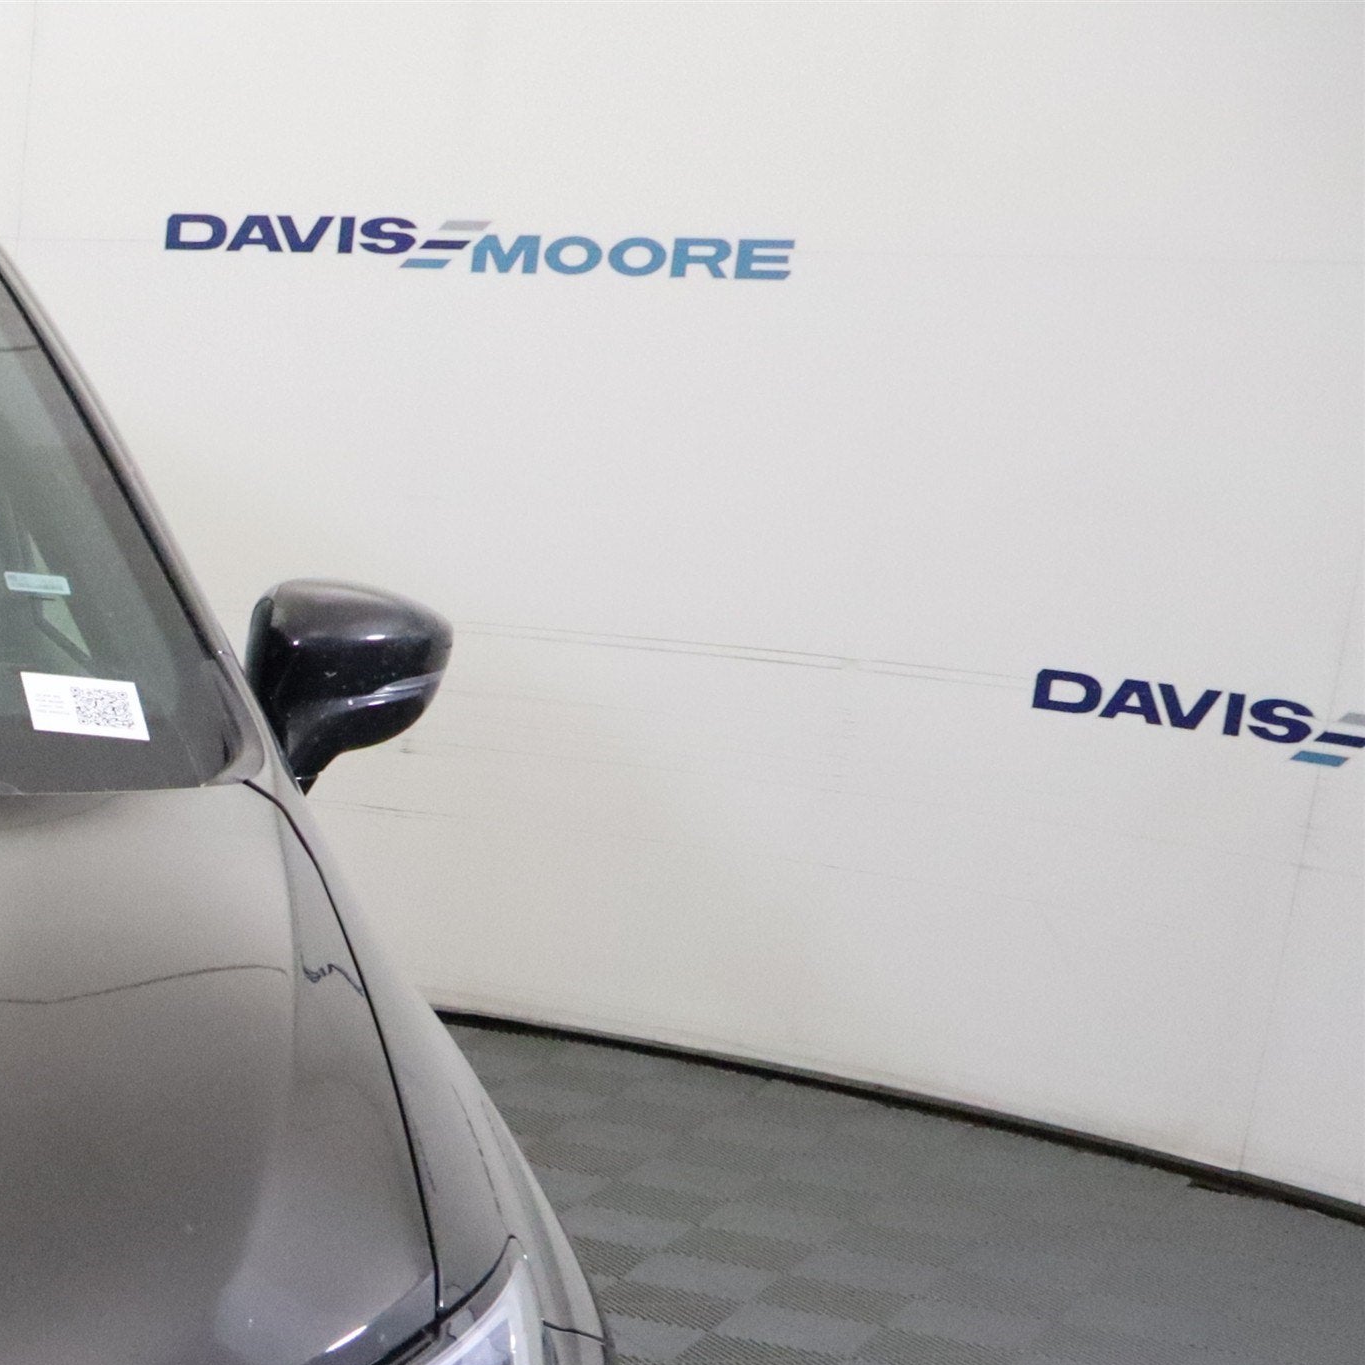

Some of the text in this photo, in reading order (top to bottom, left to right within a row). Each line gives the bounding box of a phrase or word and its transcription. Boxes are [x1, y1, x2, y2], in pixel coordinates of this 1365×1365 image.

[164, 213, 796, 280] DAVIS MOORE
[1032, 668, 1314, 744] DAVIS
